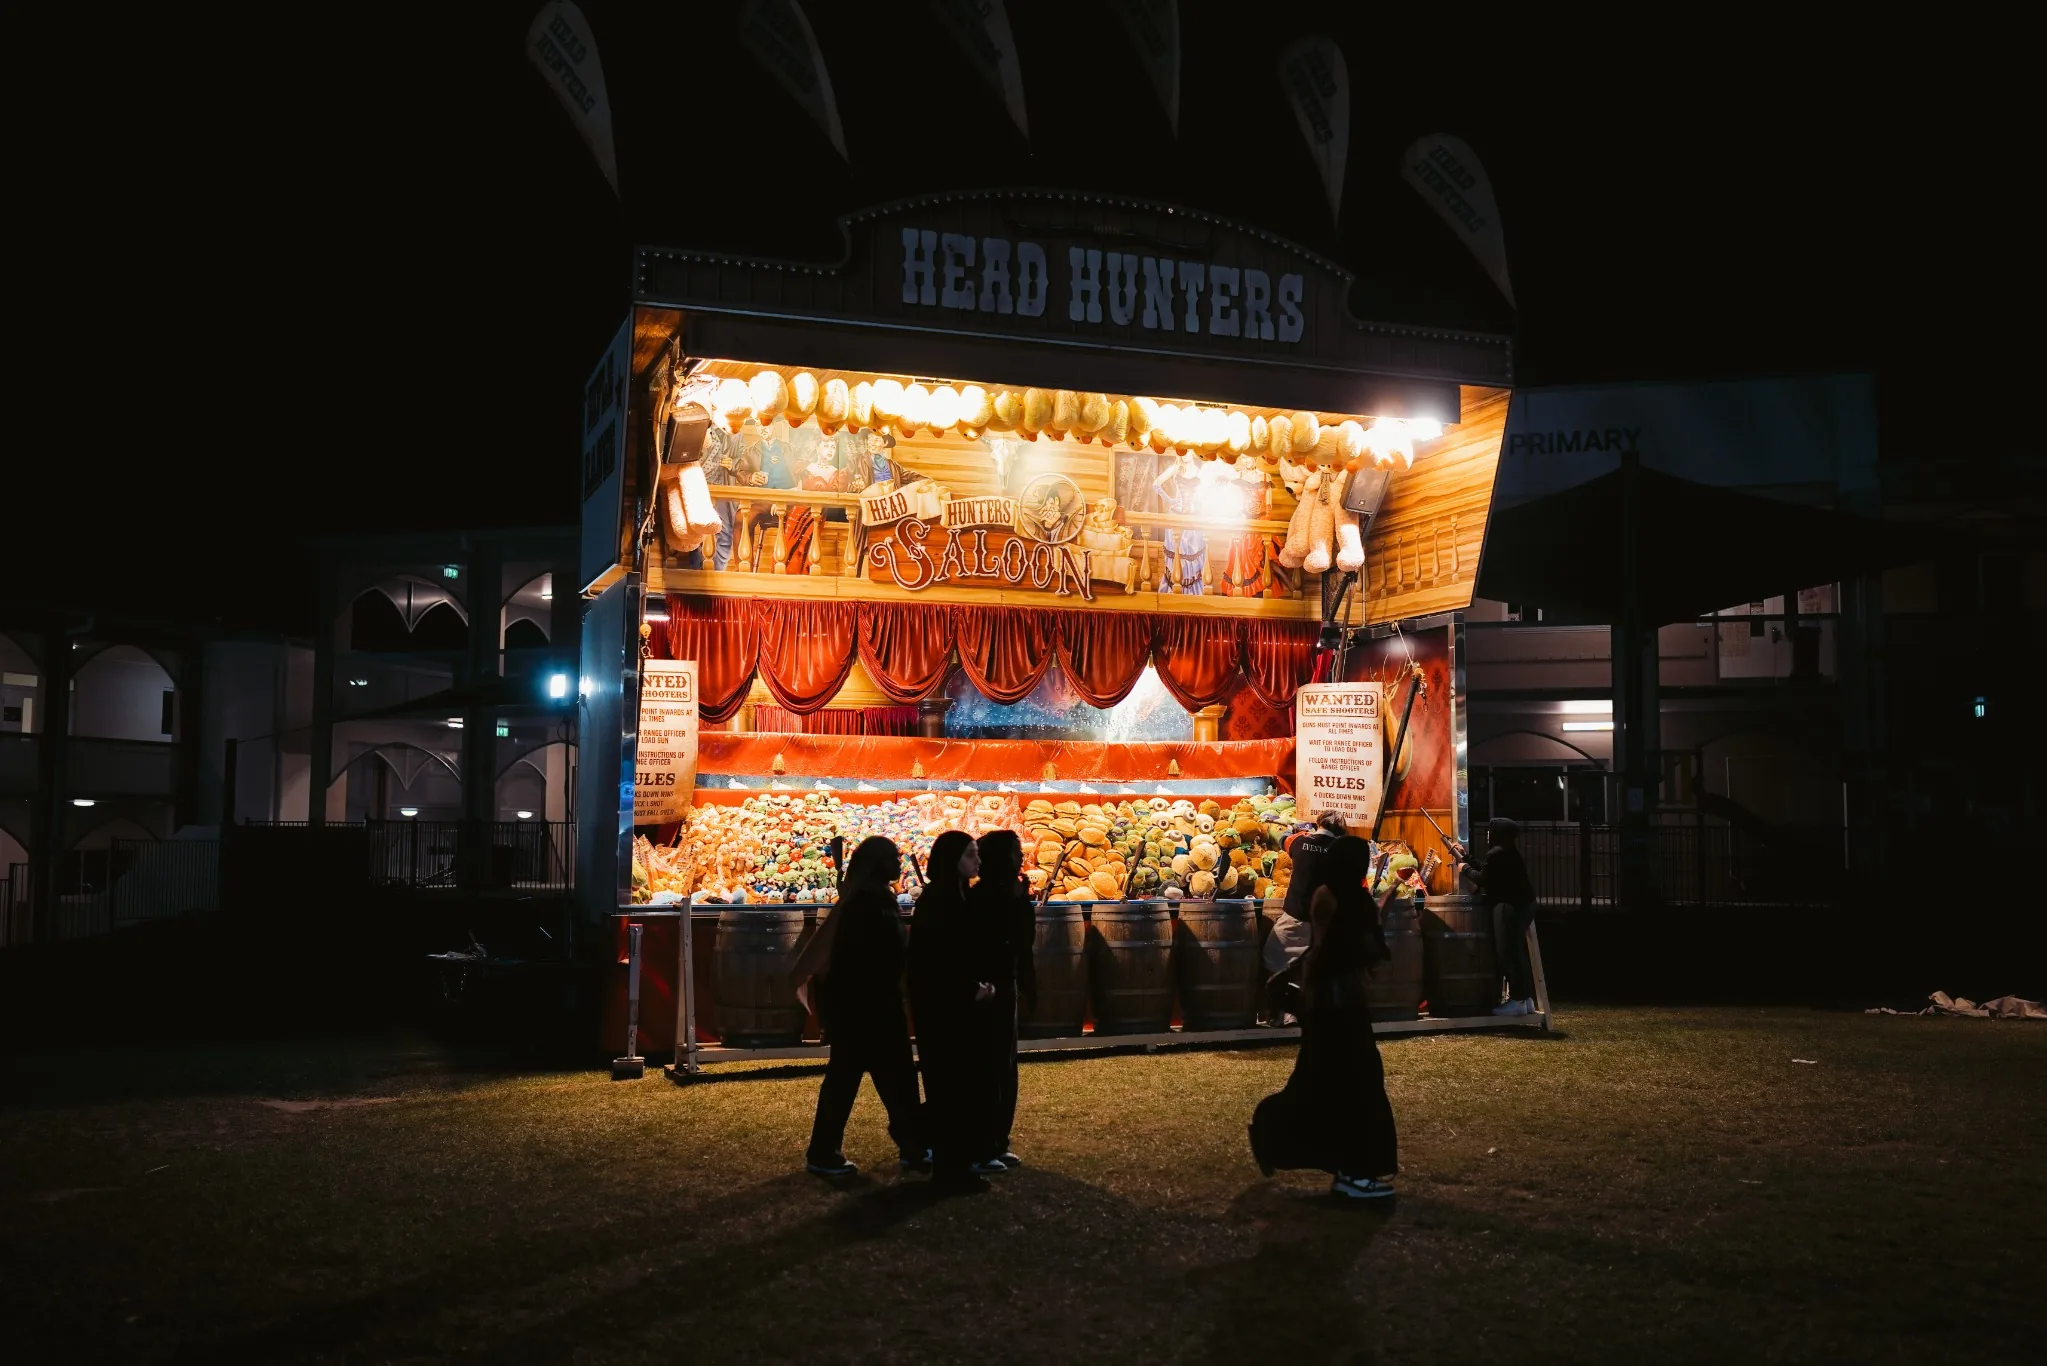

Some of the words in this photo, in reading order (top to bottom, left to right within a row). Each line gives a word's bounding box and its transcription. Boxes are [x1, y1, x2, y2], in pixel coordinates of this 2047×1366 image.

[548, 12, 587, 66] HEAD
[535, 31, 596, 115] HUNTERS
[1428, 144, 1477, 191] HEAD
[1412, 158, 1487, 234] HUNTERS
[902, 227, 1049, 317] HEAD
[1068, 246, 1305, 343] HUNTERS
[1508, 427, 1642, 456] PRIMARY
[867, 492, 908, 522] HEAD
[946, 499, 1011, 526] HUNTERS
[868, 516, 1093, 601] SALOON
[643, 675, 688, 689] NTED
[659, 708, 684, 716] INWARDS
[1304, 694, 1374, 706] WANTED
[664, 730, 686, 738] OFFICER
[638, 750, 676, 758] INSTRUCTIONS
[635, 772, 676, 786] ULES
[1314, 776, 1365, 790] RULES
